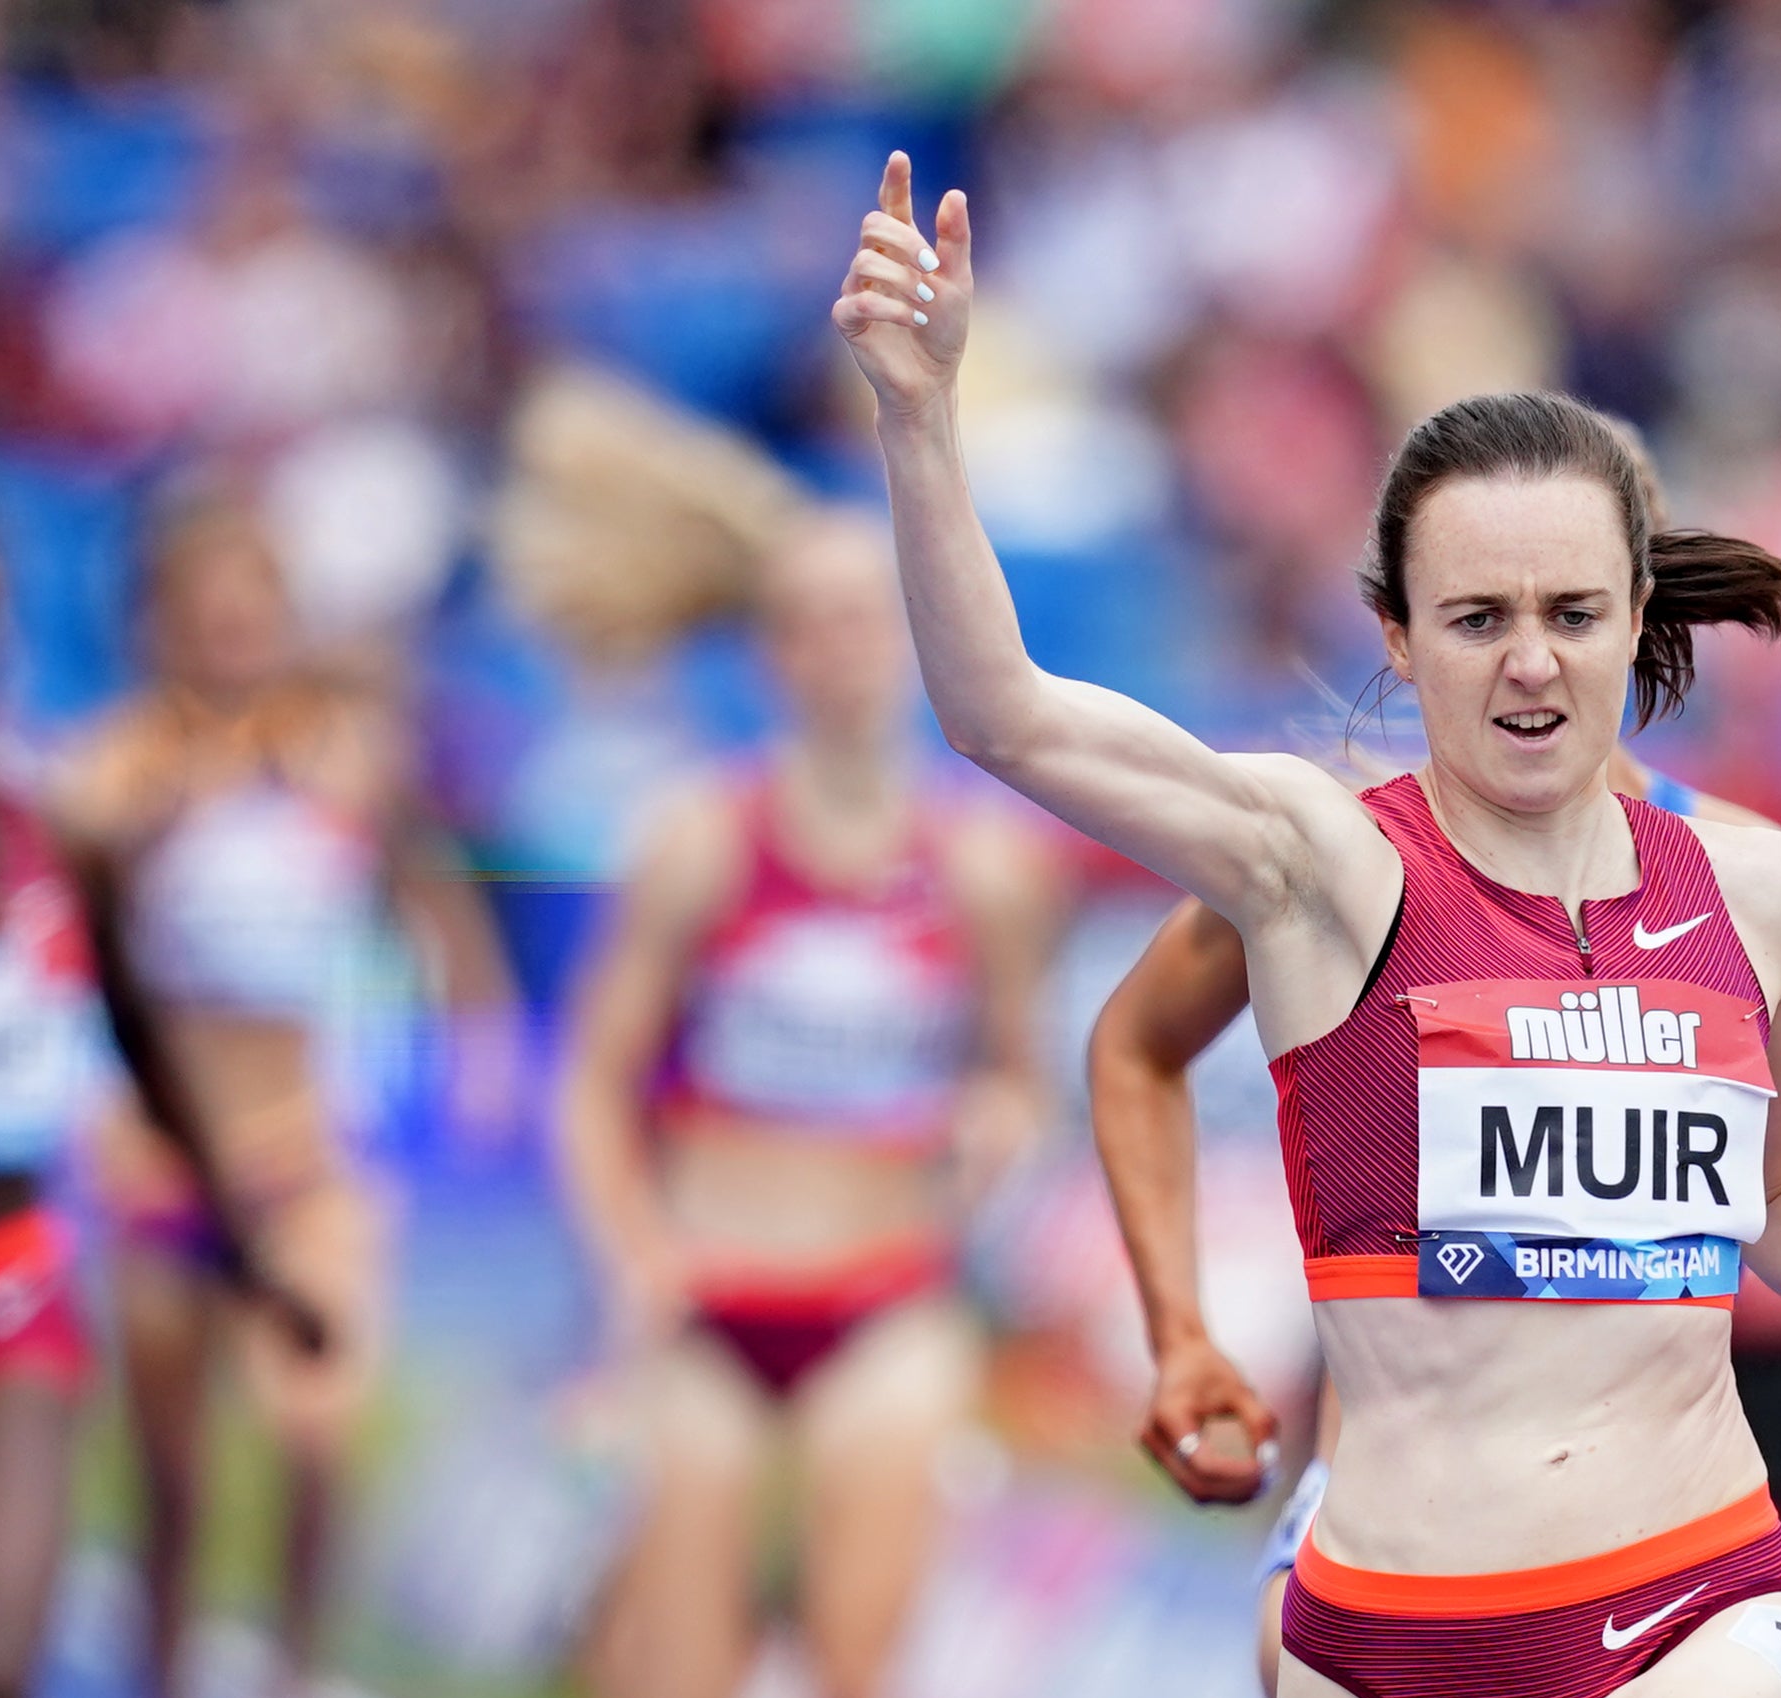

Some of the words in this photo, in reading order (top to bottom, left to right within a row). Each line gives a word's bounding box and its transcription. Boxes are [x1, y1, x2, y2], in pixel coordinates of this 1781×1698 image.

[1505, 985, 1702, 1070] müller
[1480, 1105, 1731, 1207] MUIR
[1514, 1246, 1720, 1281] BIRMINGHAM
